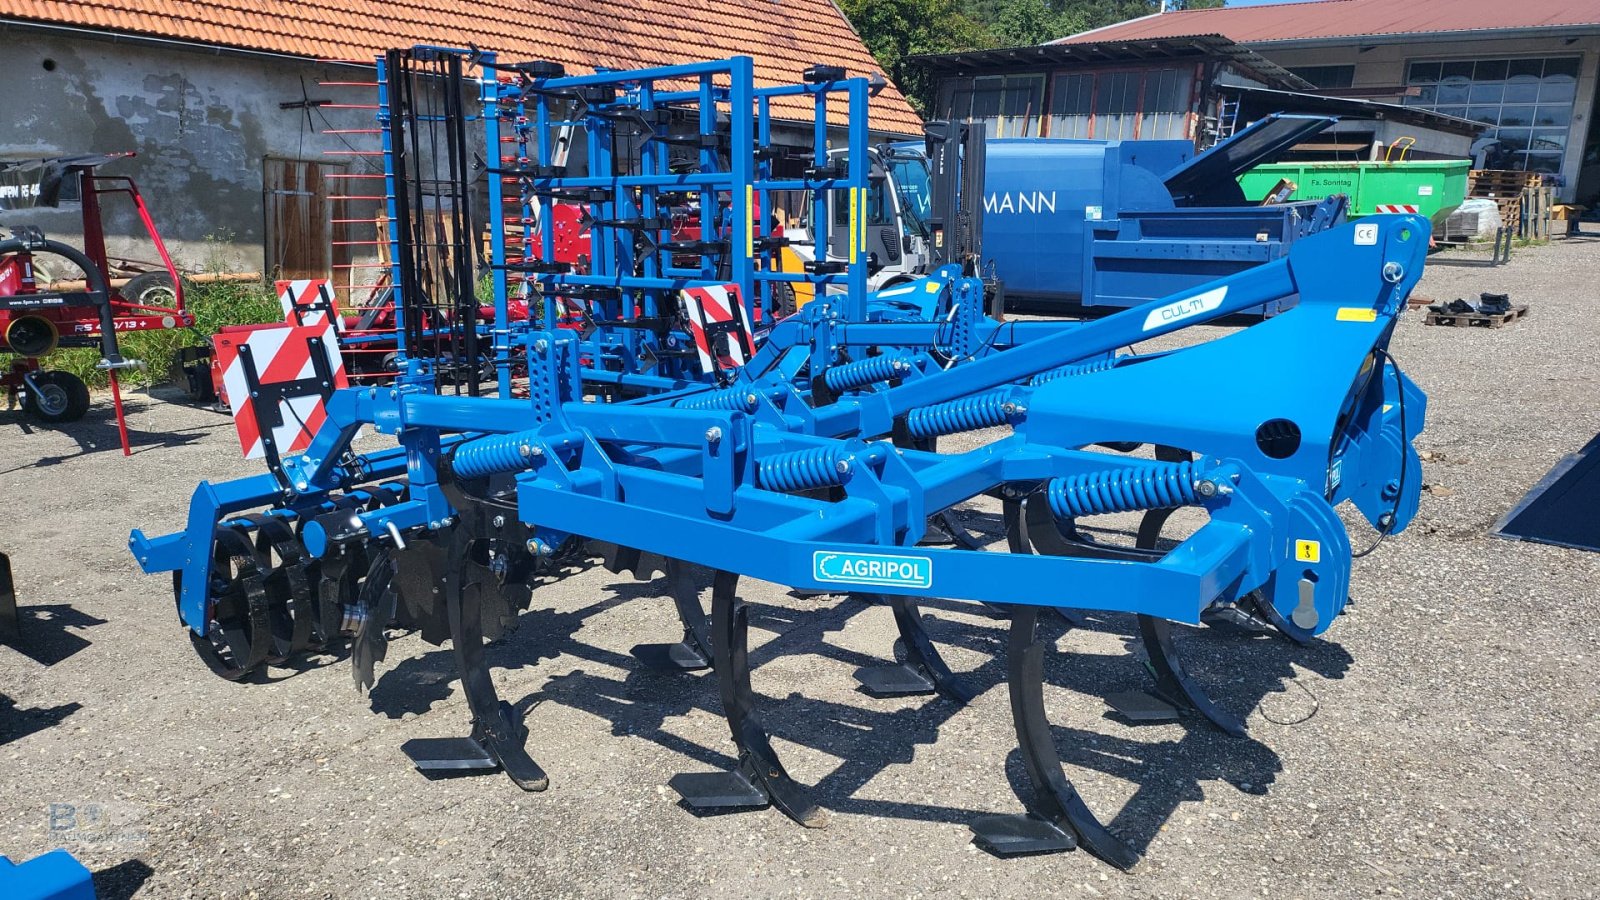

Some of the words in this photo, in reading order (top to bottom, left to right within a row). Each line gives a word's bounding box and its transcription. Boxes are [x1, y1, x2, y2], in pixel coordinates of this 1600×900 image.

[1323, 179, 1352, 187] Sonntag
[1358, 229, 1373, 239] CE
[1161, 299, 1203, 321] CULTI
[74, 323, 93, 332] RS
[95, 320, 137, 330] 40/13
[841, 559, 925, 580] AGRIPOL
